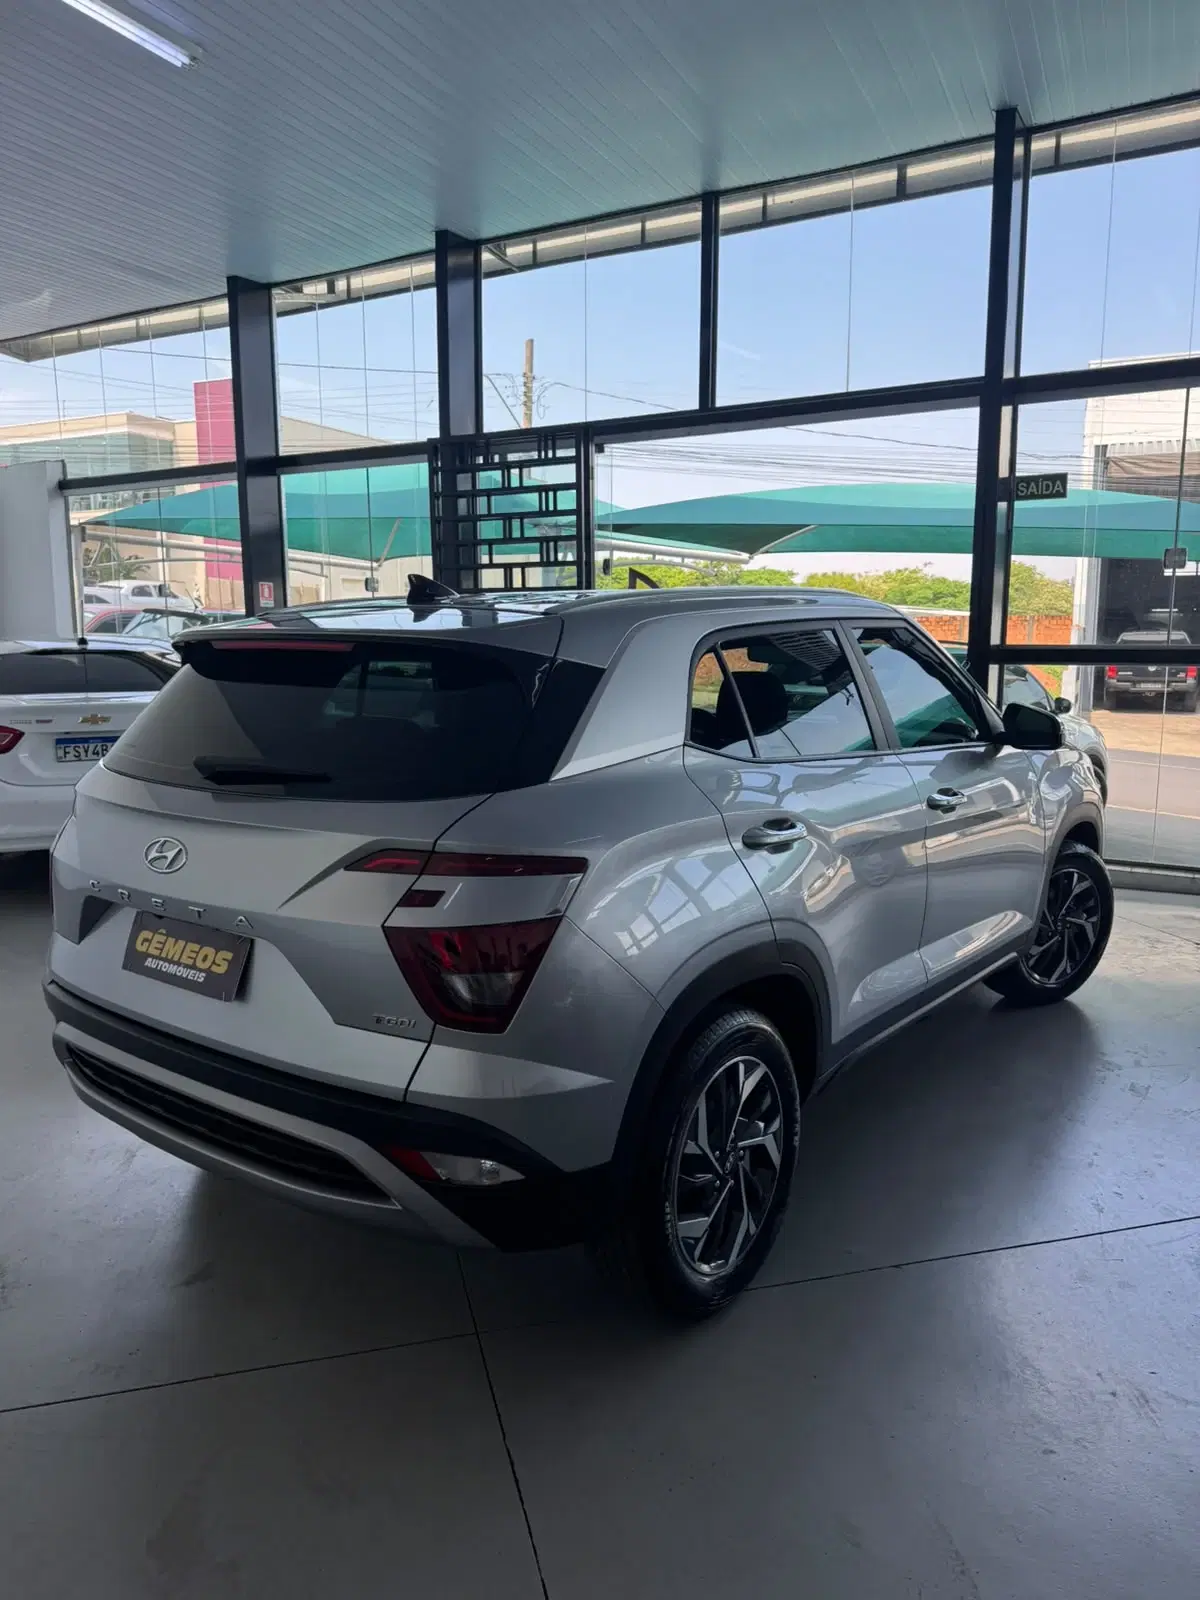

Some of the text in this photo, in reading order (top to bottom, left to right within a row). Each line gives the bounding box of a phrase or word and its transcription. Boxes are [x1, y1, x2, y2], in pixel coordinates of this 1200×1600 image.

[1017, 478, 1064, 496] SAÍDA
[63, 743, 113, 759] FSY4B
[89, 880, 254, 929] CRETA
[135, 929, 233, 974] GÊMEOS
